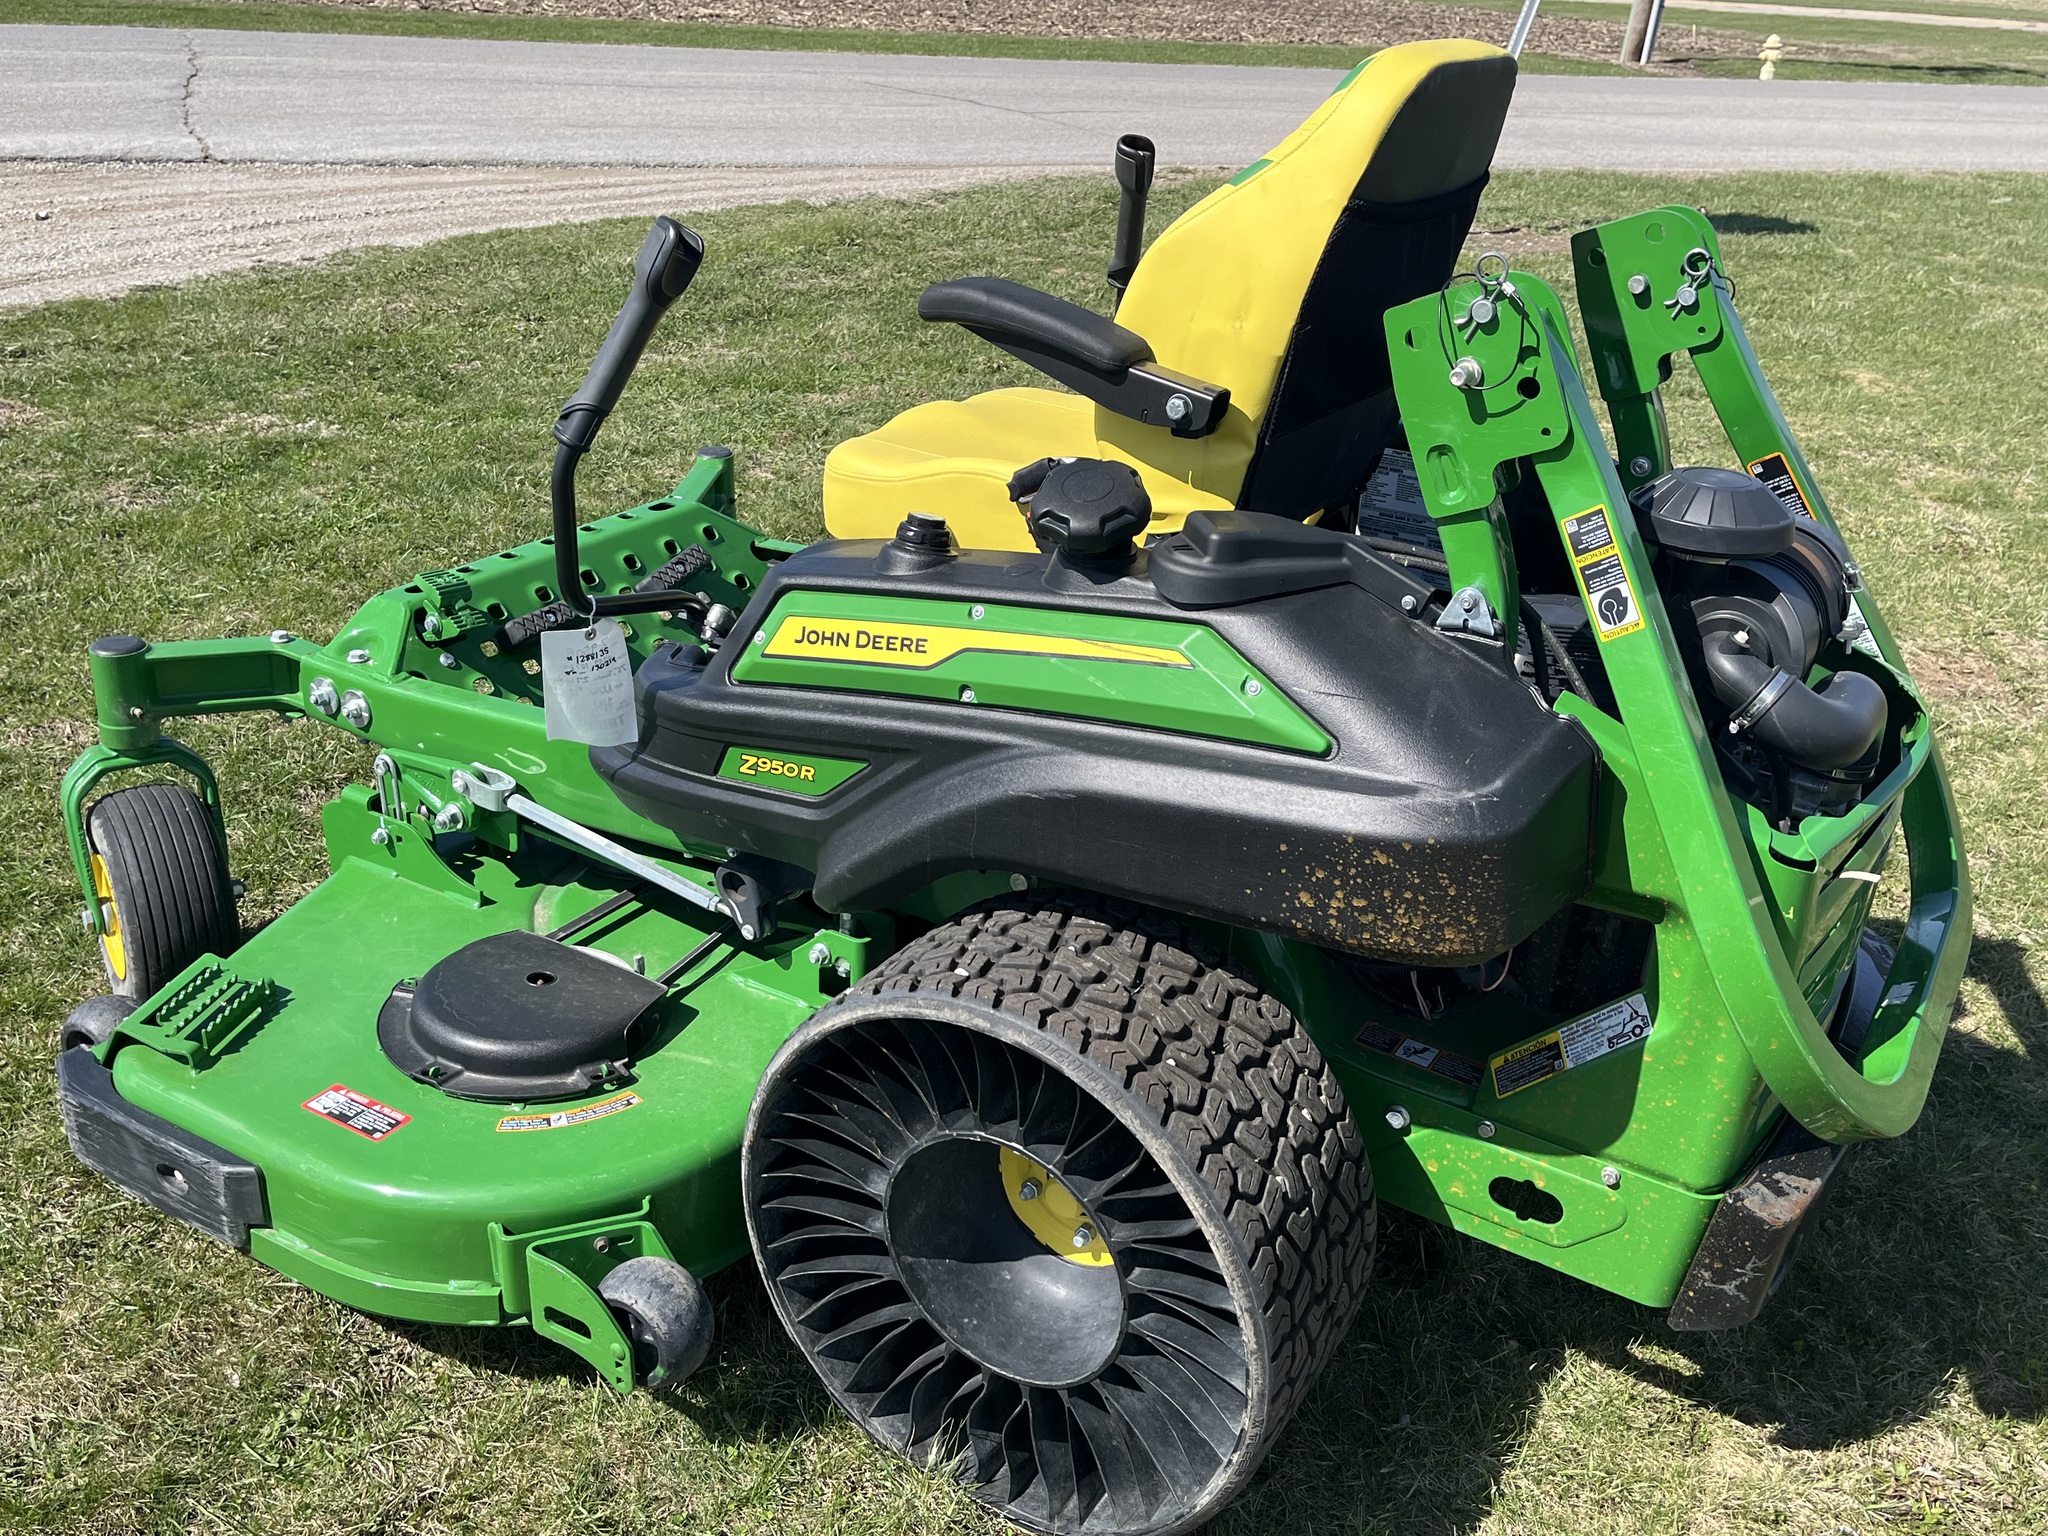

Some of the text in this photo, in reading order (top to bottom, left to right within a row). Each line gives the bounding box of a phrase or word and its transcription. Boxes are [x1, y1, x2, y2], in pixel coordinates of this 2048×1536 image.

[794, 626, 928, 654] JOHN DEERE
[1603, 624, 1635, 640] CAUTION
[576, 647, 609, 664] 1288135
[1027, 1034, 1124, 1104] MICHELIN
